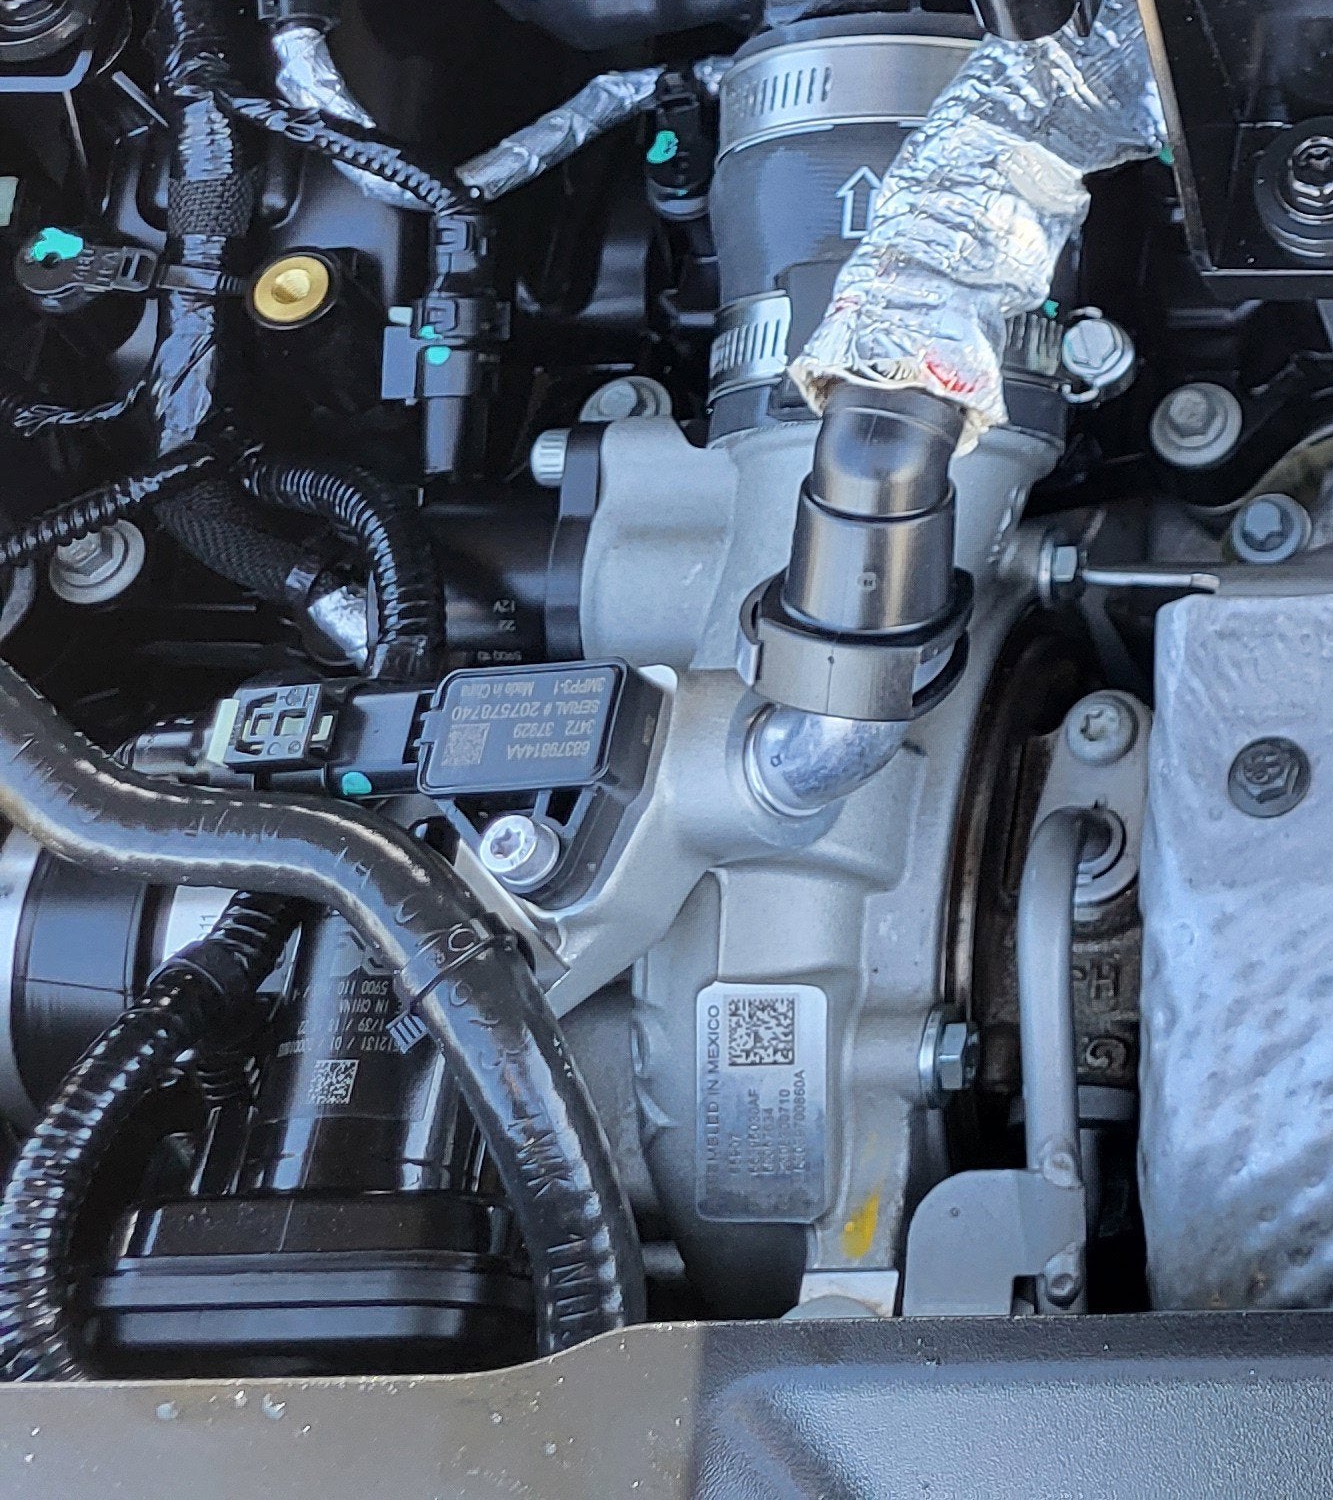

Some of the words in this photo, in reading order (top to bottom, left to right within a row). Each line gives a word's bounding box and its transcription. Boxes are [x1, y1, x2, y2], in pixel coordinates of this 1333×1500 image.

[459, 683, 491, 700] China
[493, 684, 502, 698] in
[504, 680, 535, 697] Made
[555, 699, 600, 715] SERIAL
[706, 1004, 720, 1075] MEXICO
[706, 1078, 720, 1096] IN
